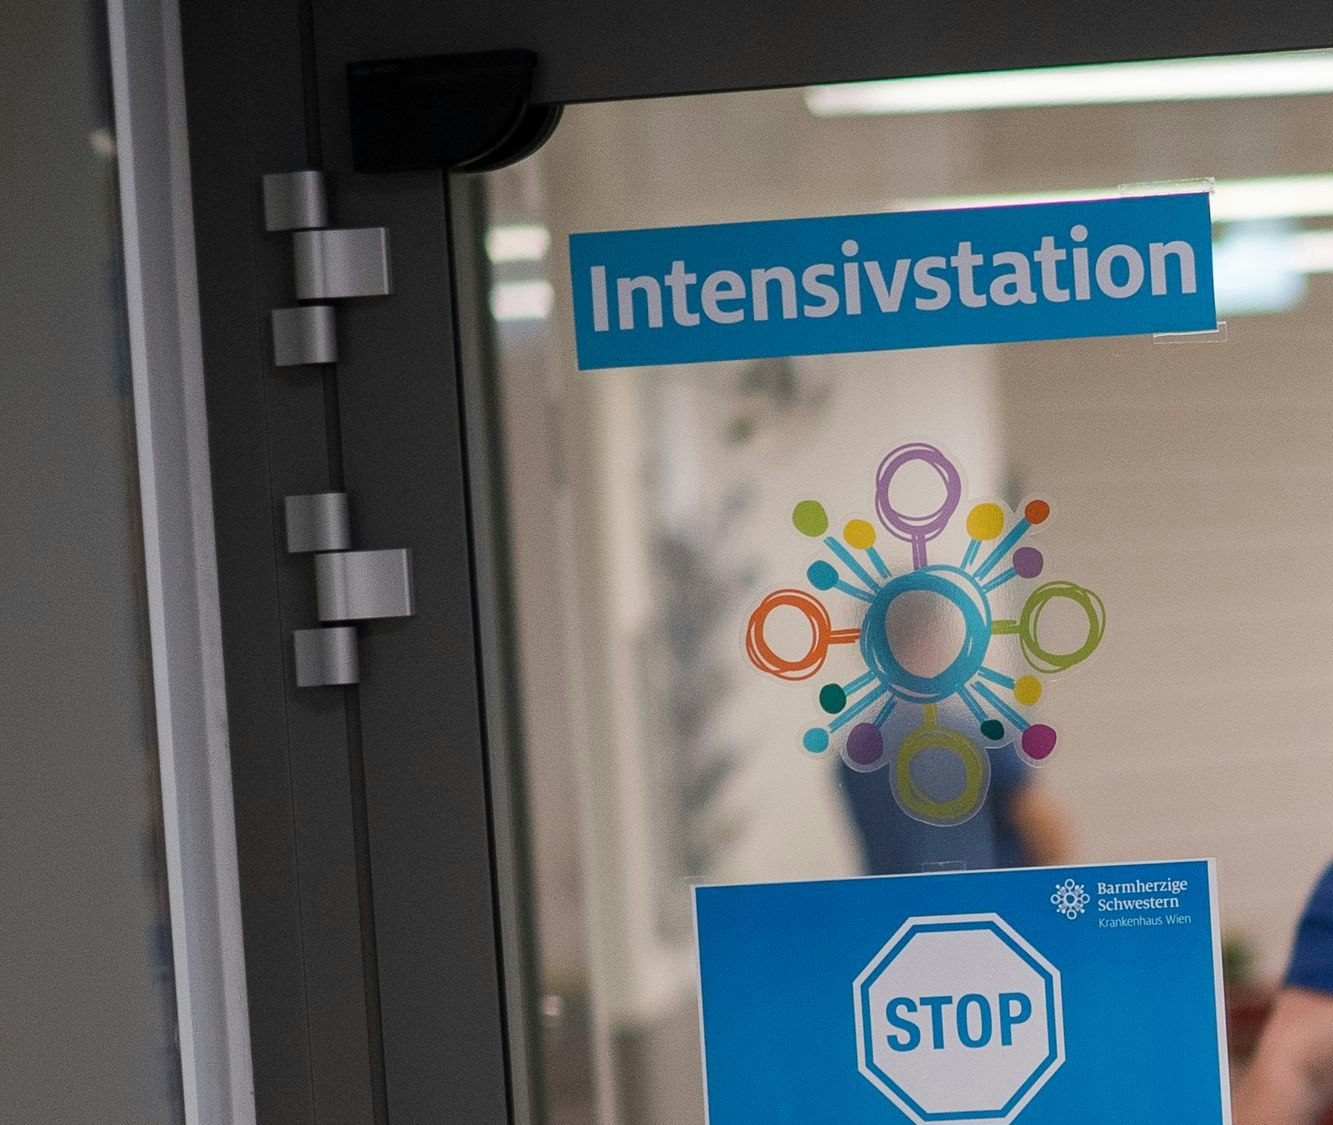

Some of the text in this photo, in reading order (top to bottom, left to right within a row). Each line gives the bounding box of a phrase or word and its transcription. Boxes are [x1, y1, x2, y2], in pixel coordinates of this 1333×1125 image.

[590, 225, 1196, 332] Intensivstation
[1097, 878, 1188, 895] Barmherzige
[1098, 897, 1179, 912] Schwestern
[1099, 914, 1192, 928] Krankenhaus Wien
[885, 992, 1032, 1052] STOP
